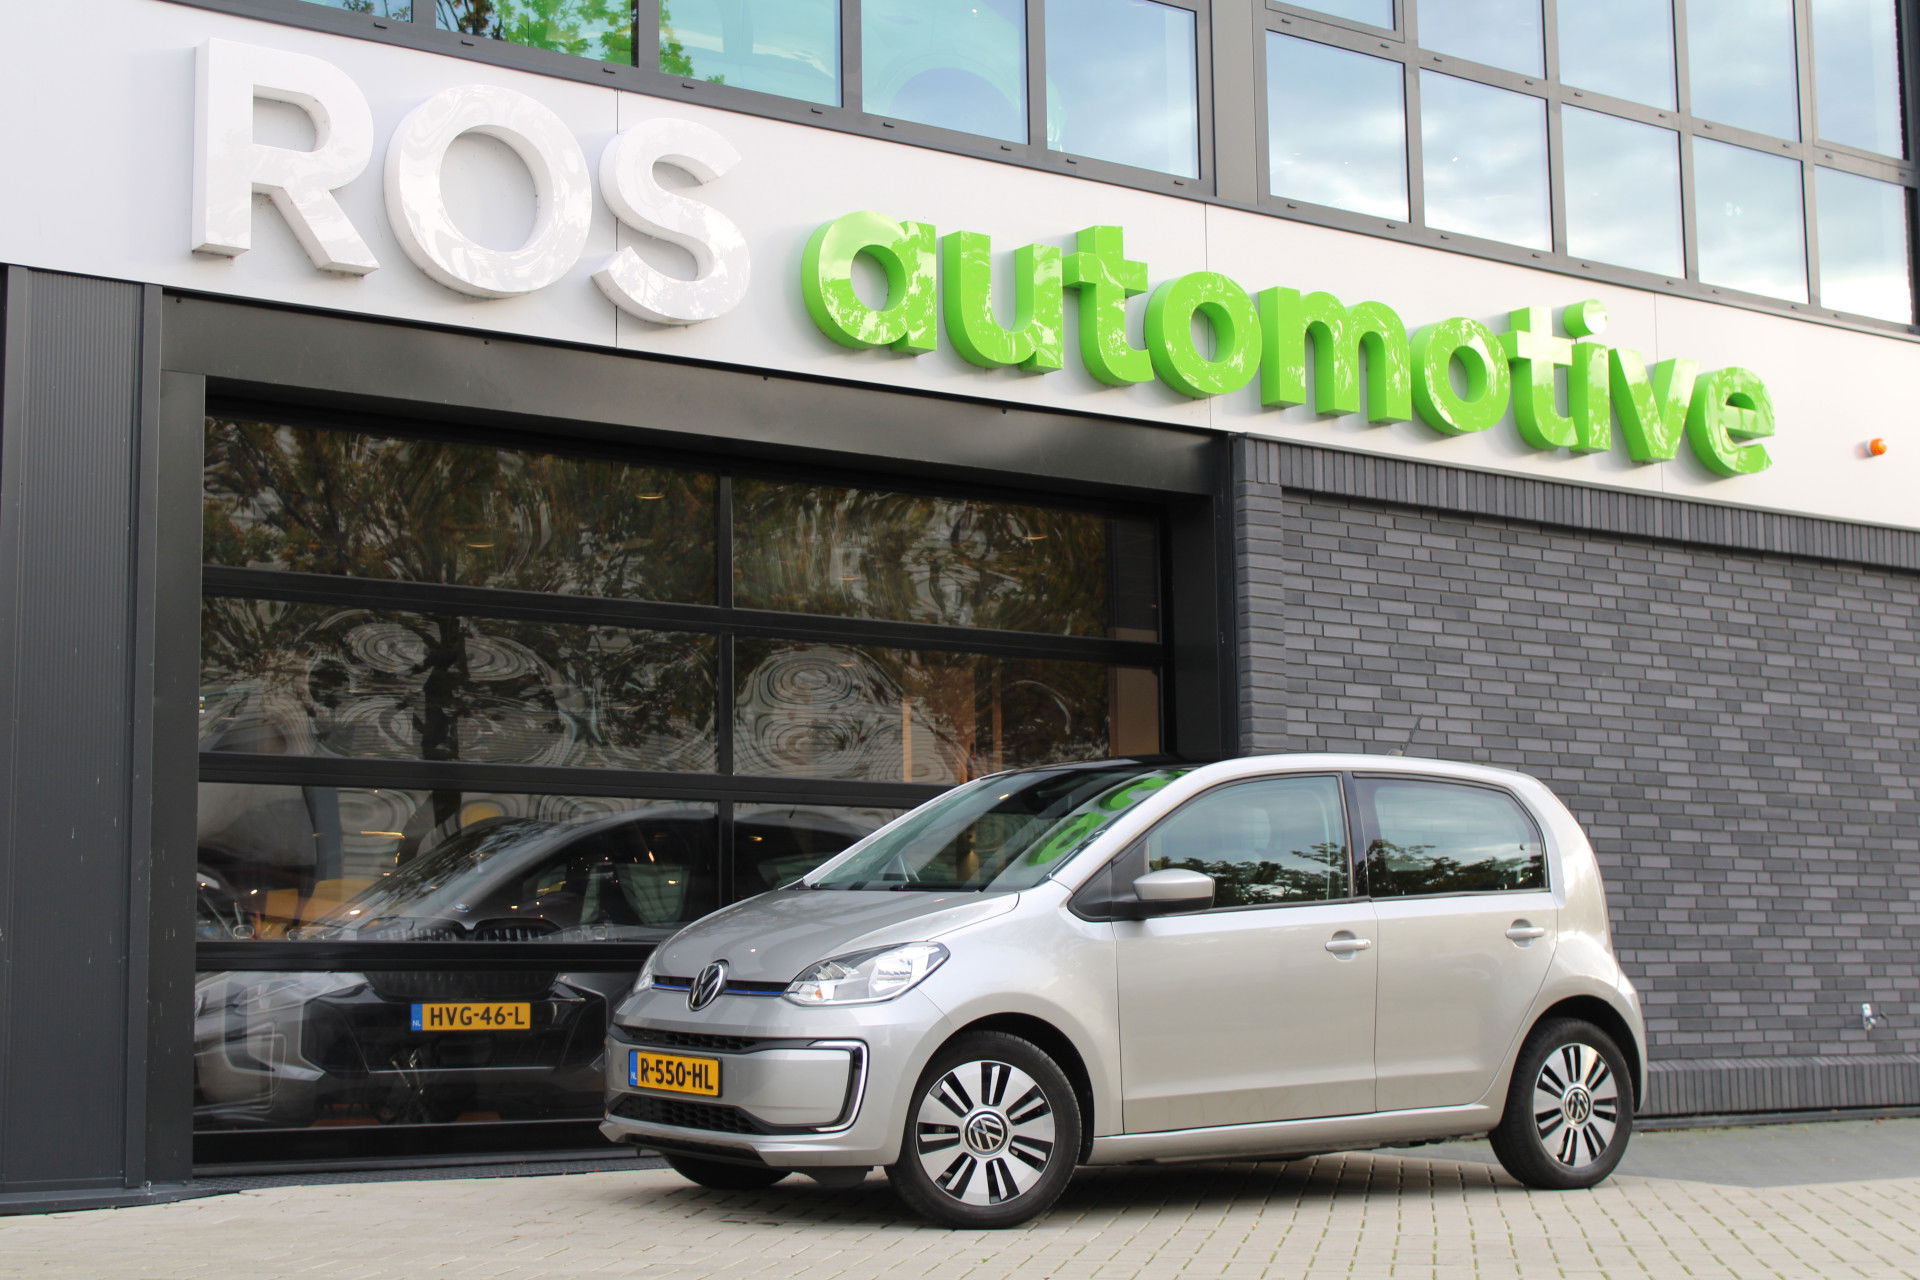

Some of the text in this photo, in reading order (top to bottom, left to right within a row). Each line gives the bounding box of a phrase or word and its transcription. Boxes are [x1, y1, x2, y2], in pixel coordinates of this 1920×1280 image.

[192, 38, 1775, 477] ROS automotive
[412, 1006, 525, 1027] NL HVG-46-L
[640, 1057, 714, 1090] R-550-HL
